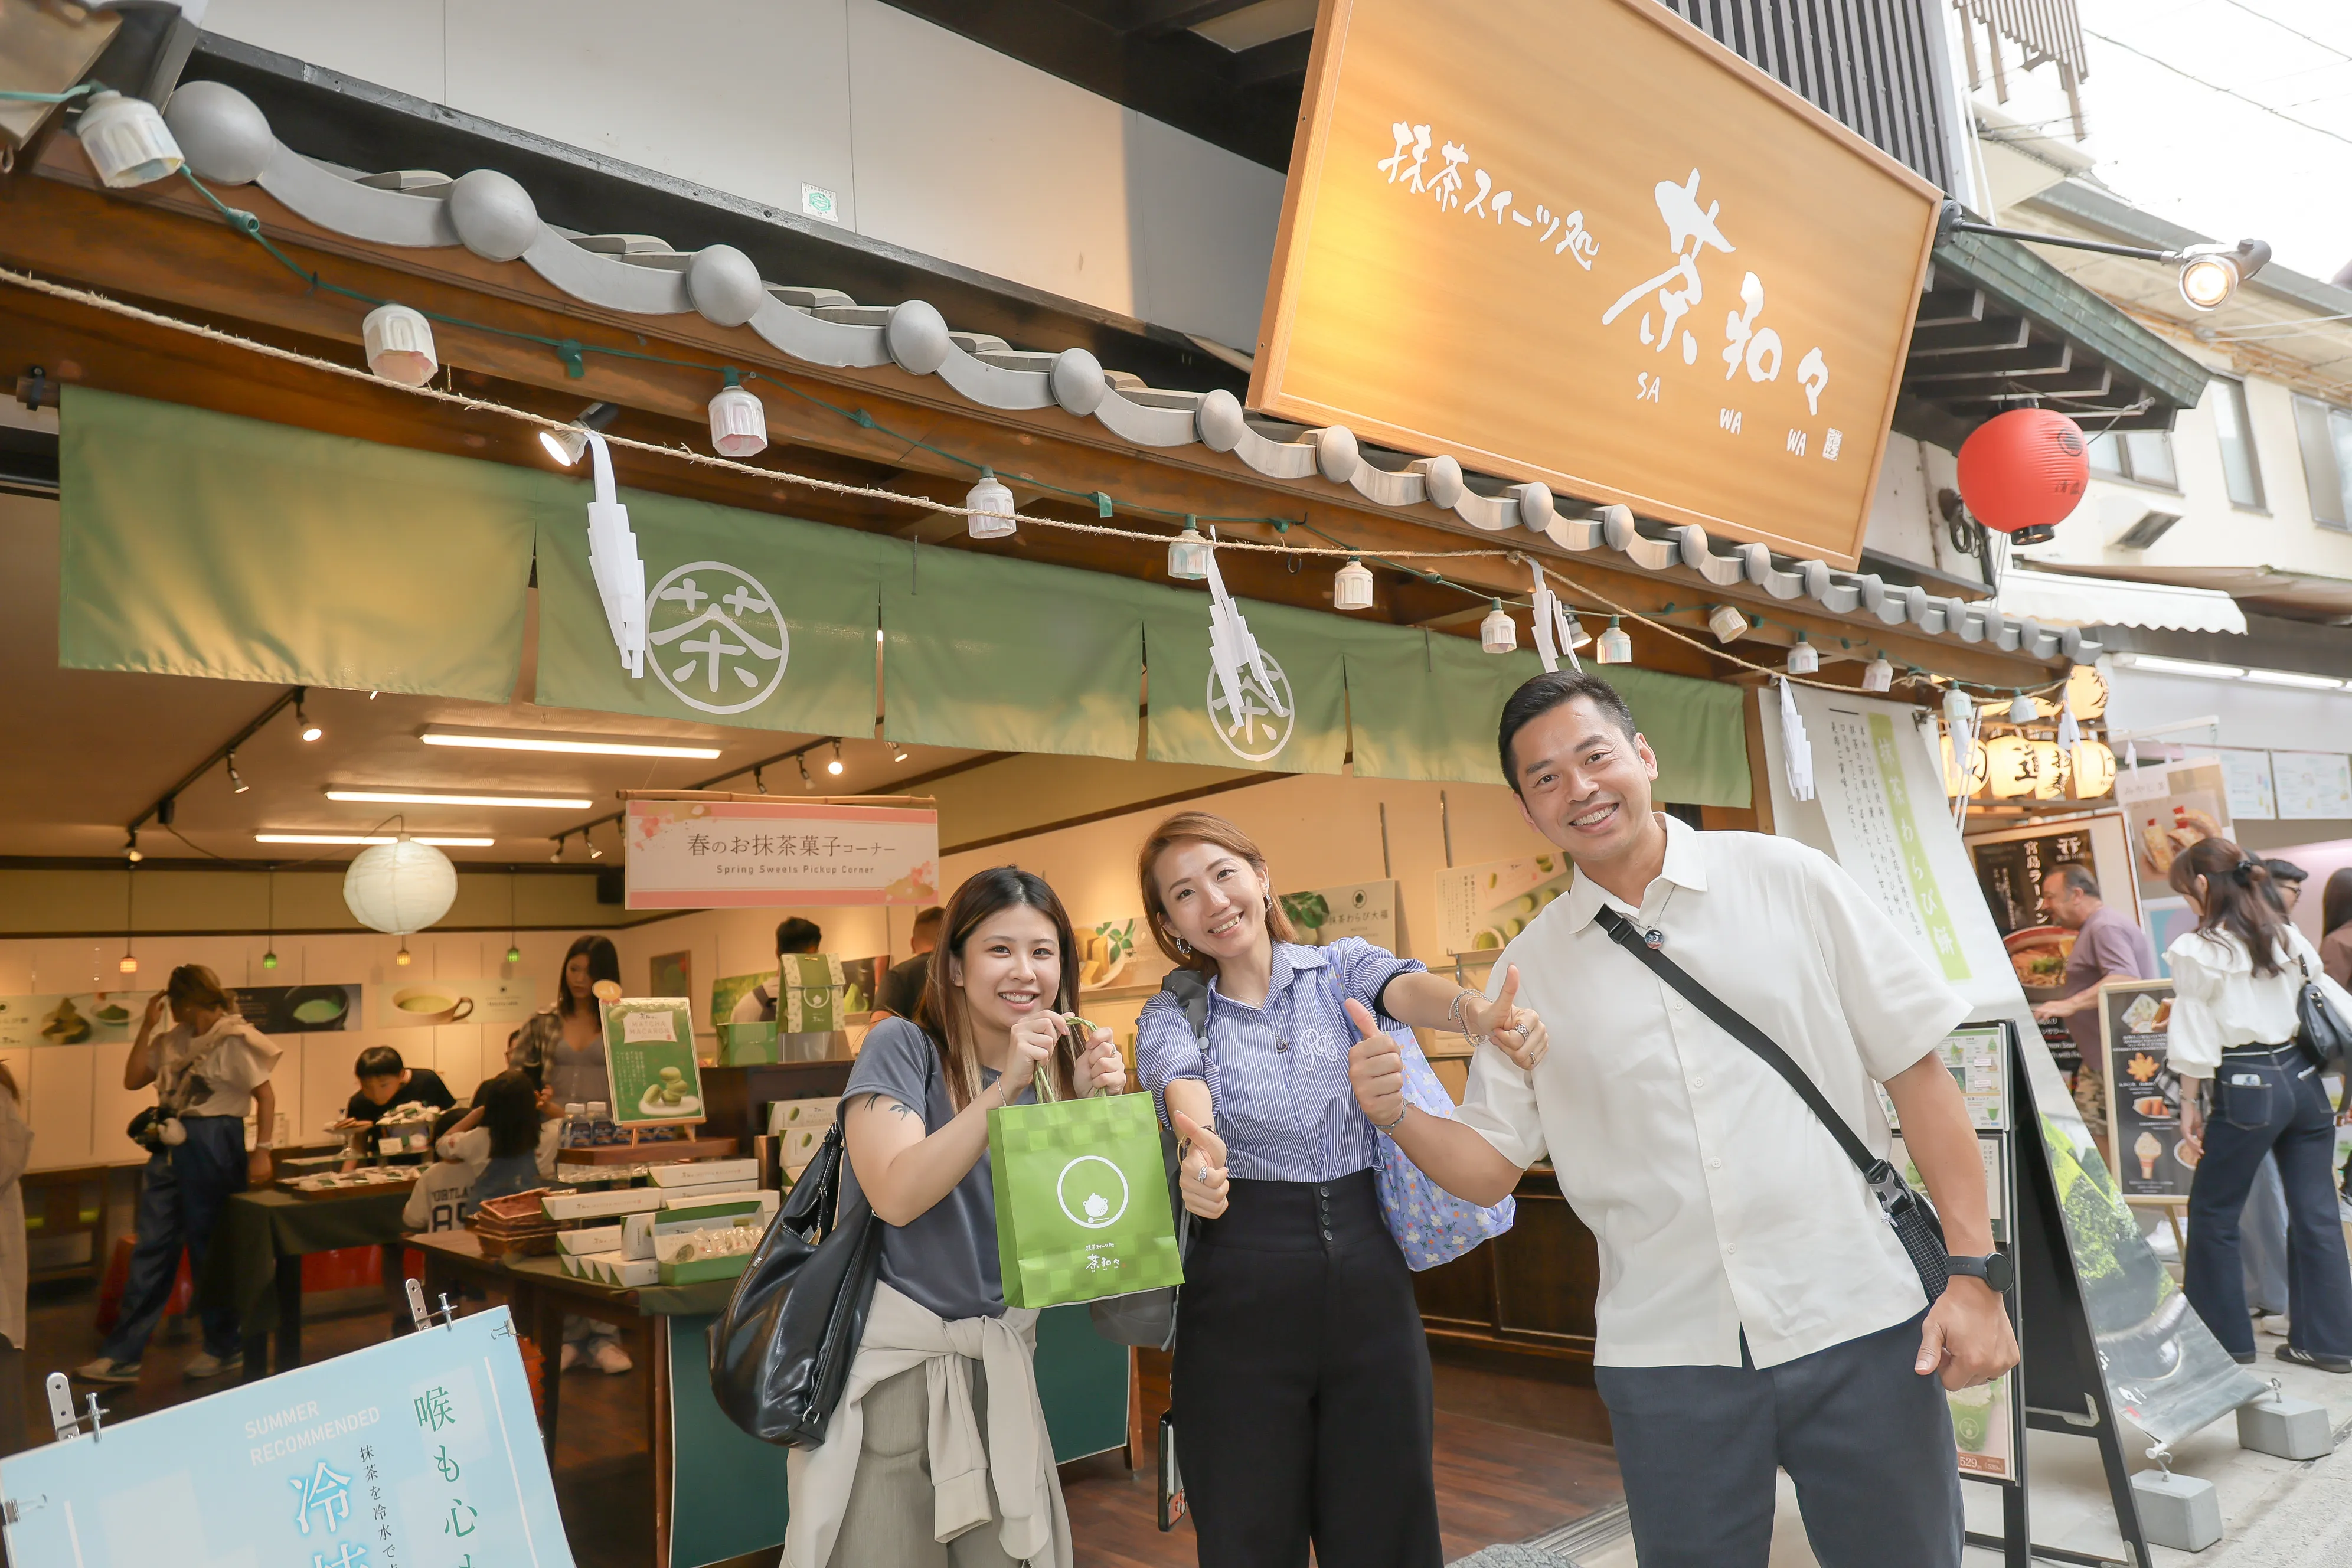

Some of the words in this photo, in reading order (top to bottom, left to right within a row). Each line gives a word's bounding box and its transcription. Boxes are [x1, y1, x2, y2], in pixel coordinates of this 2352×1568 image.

[1377, 121, 1600, 270] 抹茶スイーツ処
[1602, 168, 1829, 415] 茶和々
[1637, 373, 1660, 403] SA
[1720, 408, 1742, 435] WA
[1787, 429, 1807, 456] WA
[650, 578, 785, 692] 茶
[687, 833, 896, 857] 春のお抹茶菓子コーナー
[716, 865, 754, 875] Spring
[759, 865, 798, 874] Sweets
[803, 865, 837, 874] Pickup
[841, 865, 875, 874] Corner
[245, 1400, 319, 1439] SUMMER
[250, 1406, 380, 1466] RECOMMENDED
[359, 1445, 399, 1568] 抹茶を冷水で
